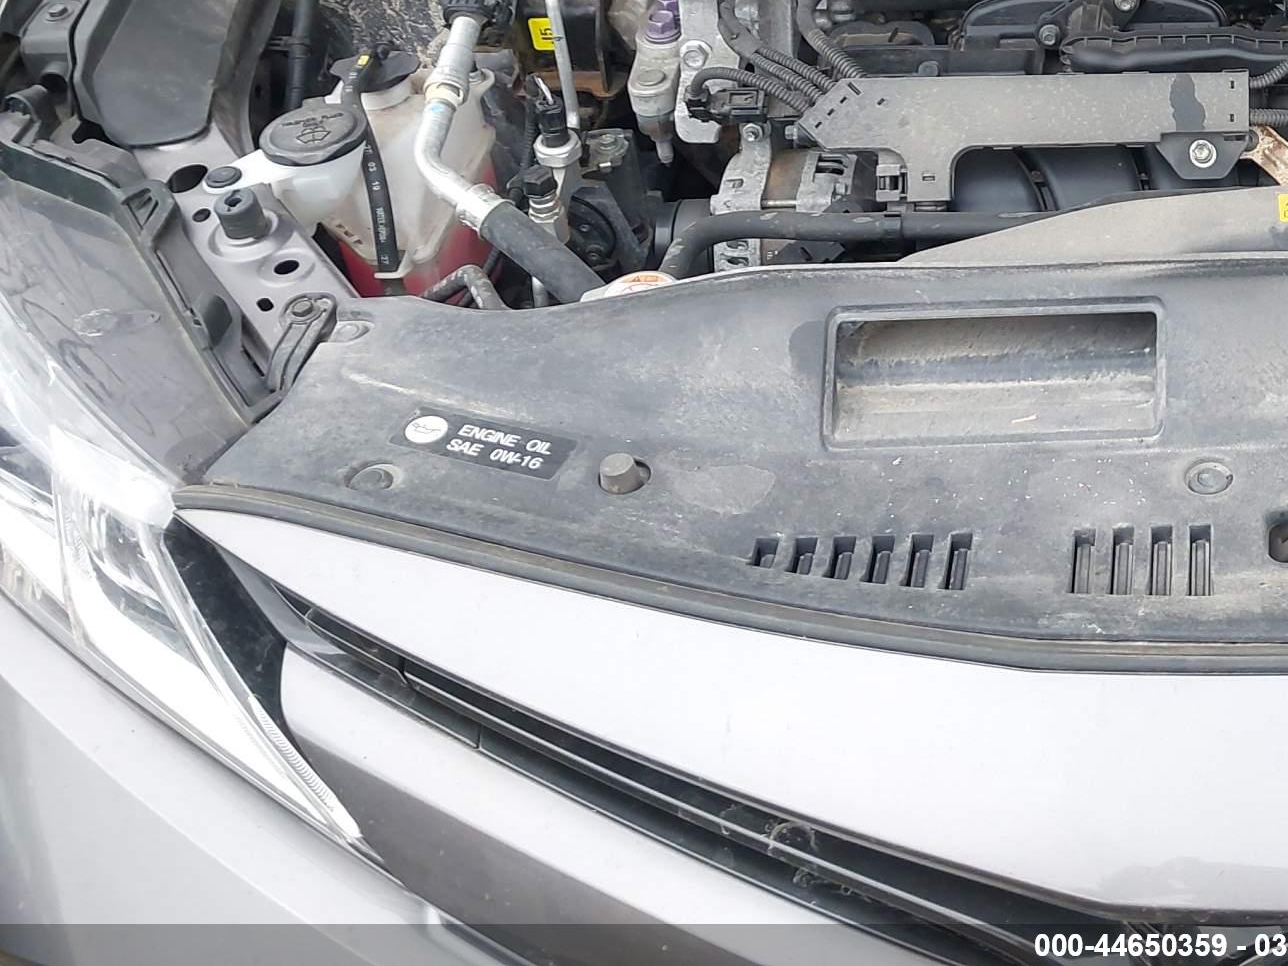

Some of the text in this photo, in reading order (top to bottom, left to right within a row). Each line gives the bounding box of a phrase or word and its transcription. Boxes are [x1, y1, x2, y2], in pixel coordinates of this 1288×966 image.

[446, 438, 544, 470] SAE 0W-16
[457, 424, 553, 455] ENGINE OIL
